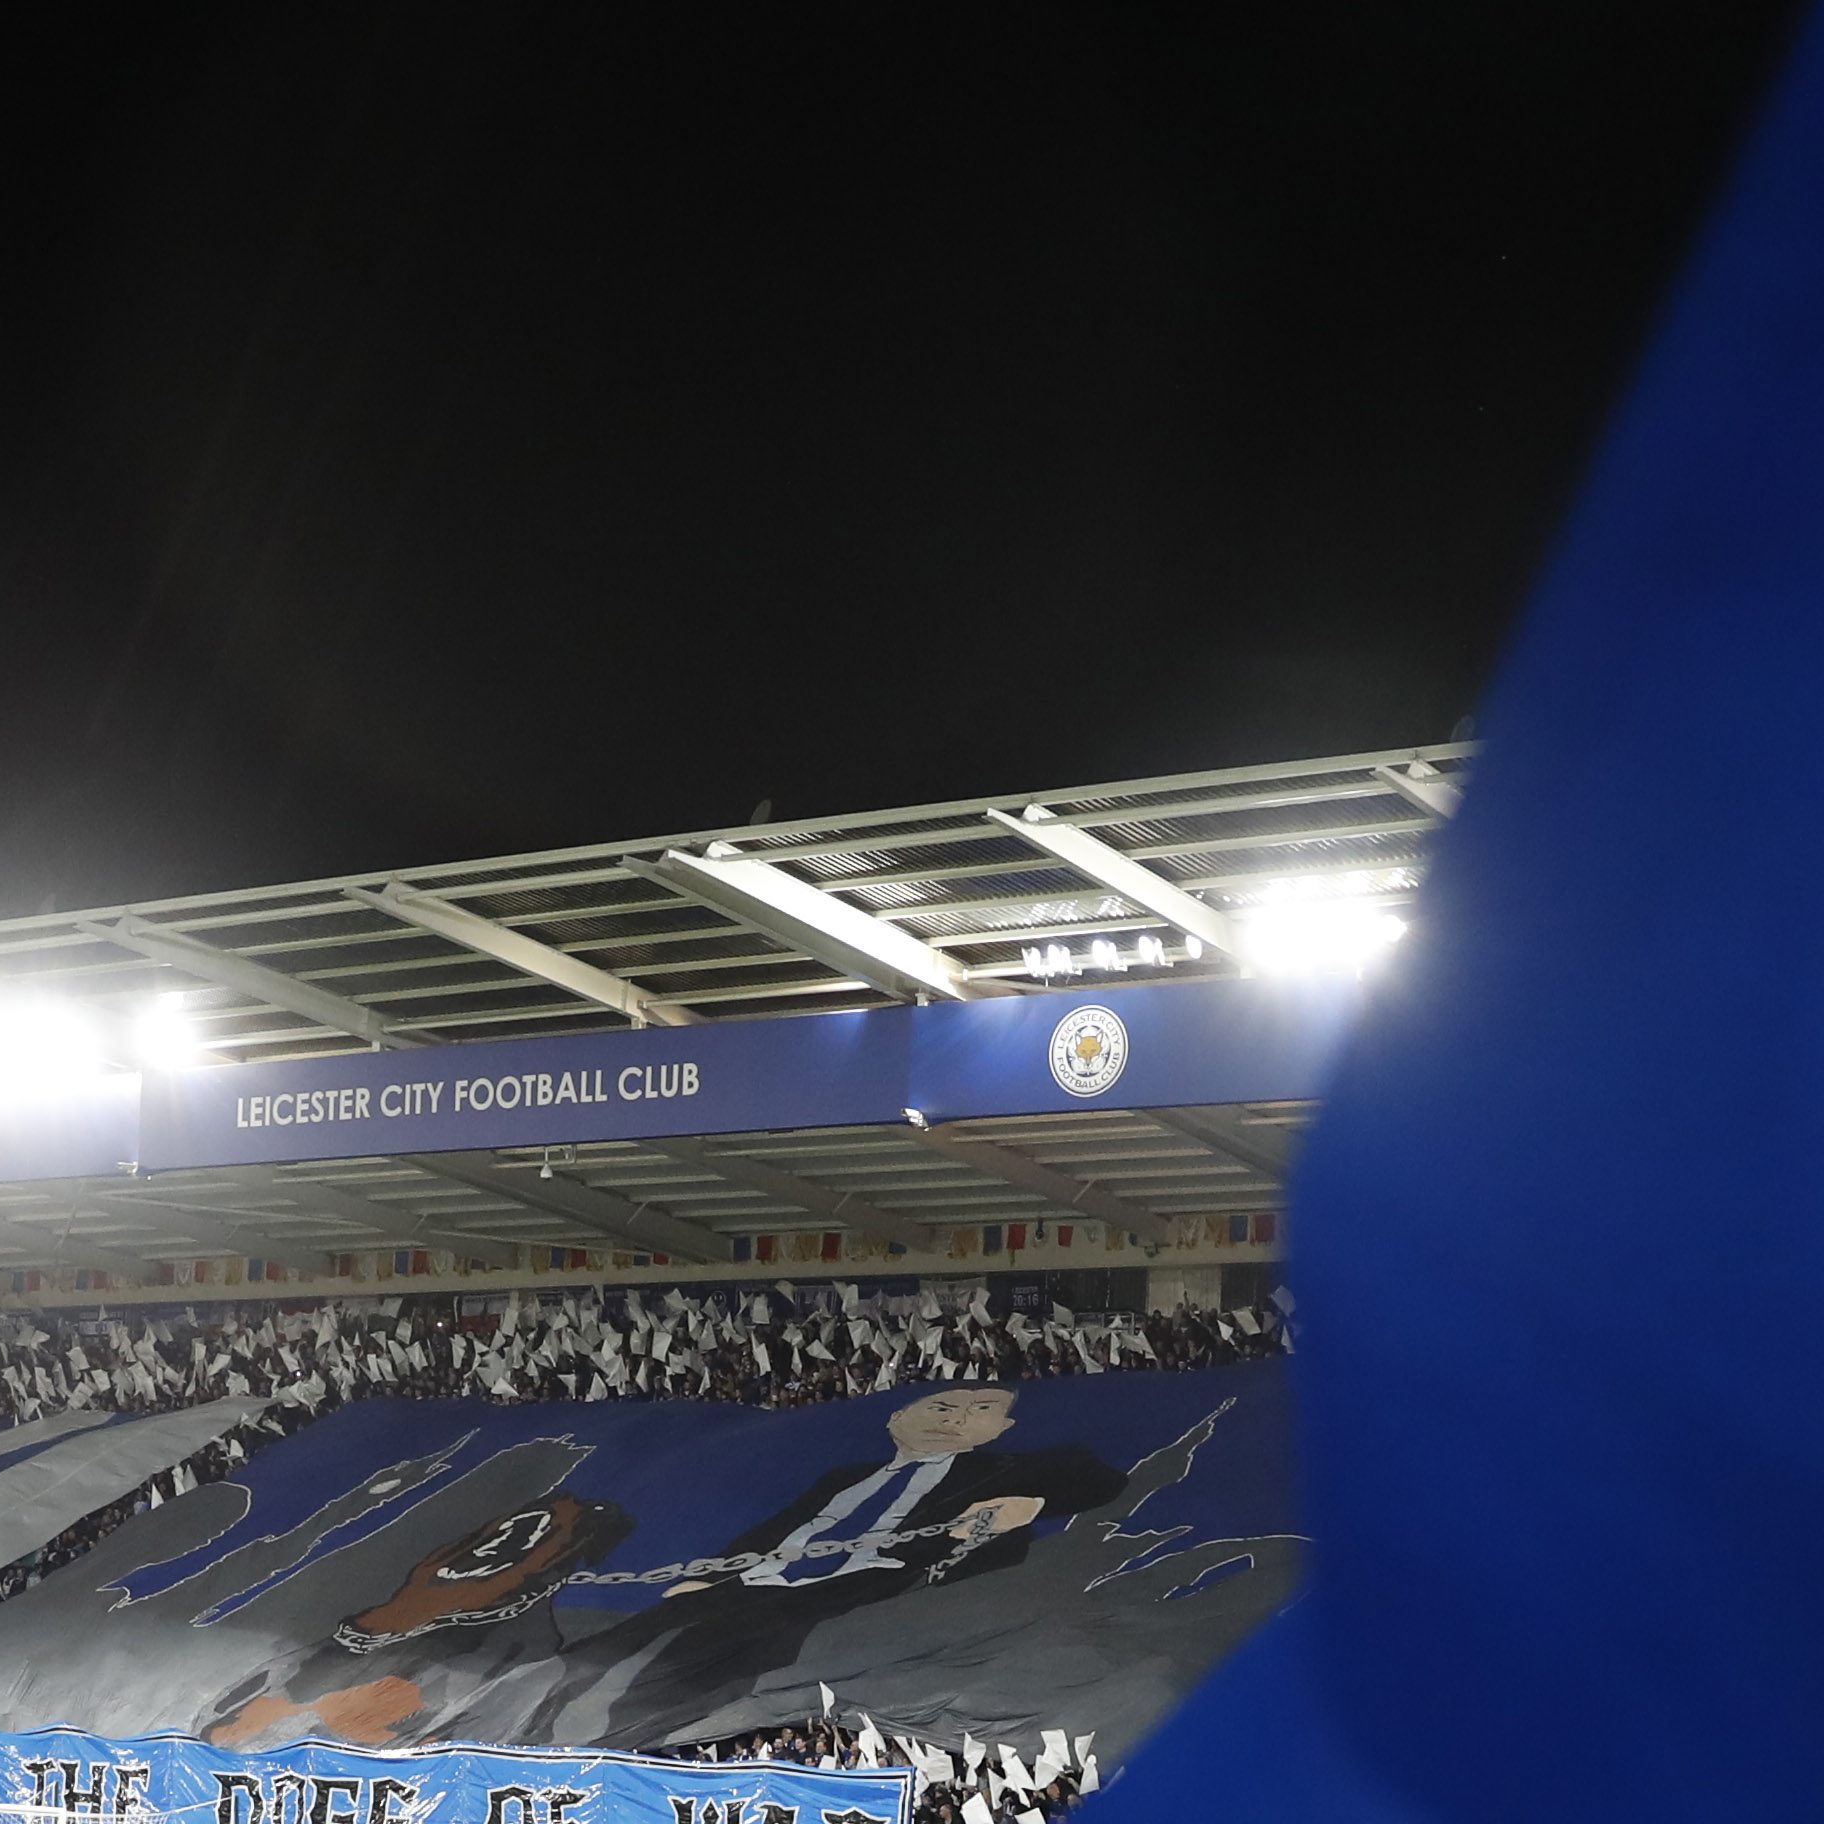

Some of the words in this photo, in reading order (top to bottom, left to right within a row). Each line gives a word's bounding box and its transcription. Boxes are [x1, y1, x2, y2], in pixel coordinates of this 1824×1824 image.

[1058, 1013, 1106, 1050] LEICESTER
[1106, 1021, 1122, 1047] CITY
[1057, 1057, 1101, 1089] FOOTBALL
[1101, 1052, 1121, 1082] CLUB
[236, 1087, 370, 1128] LEICESTER
[380, 1081, 444, 1117] CITY
[455, 1070, 608, 1112] FOOTBALL
[618, 1062, 701, 1100] CLUB
